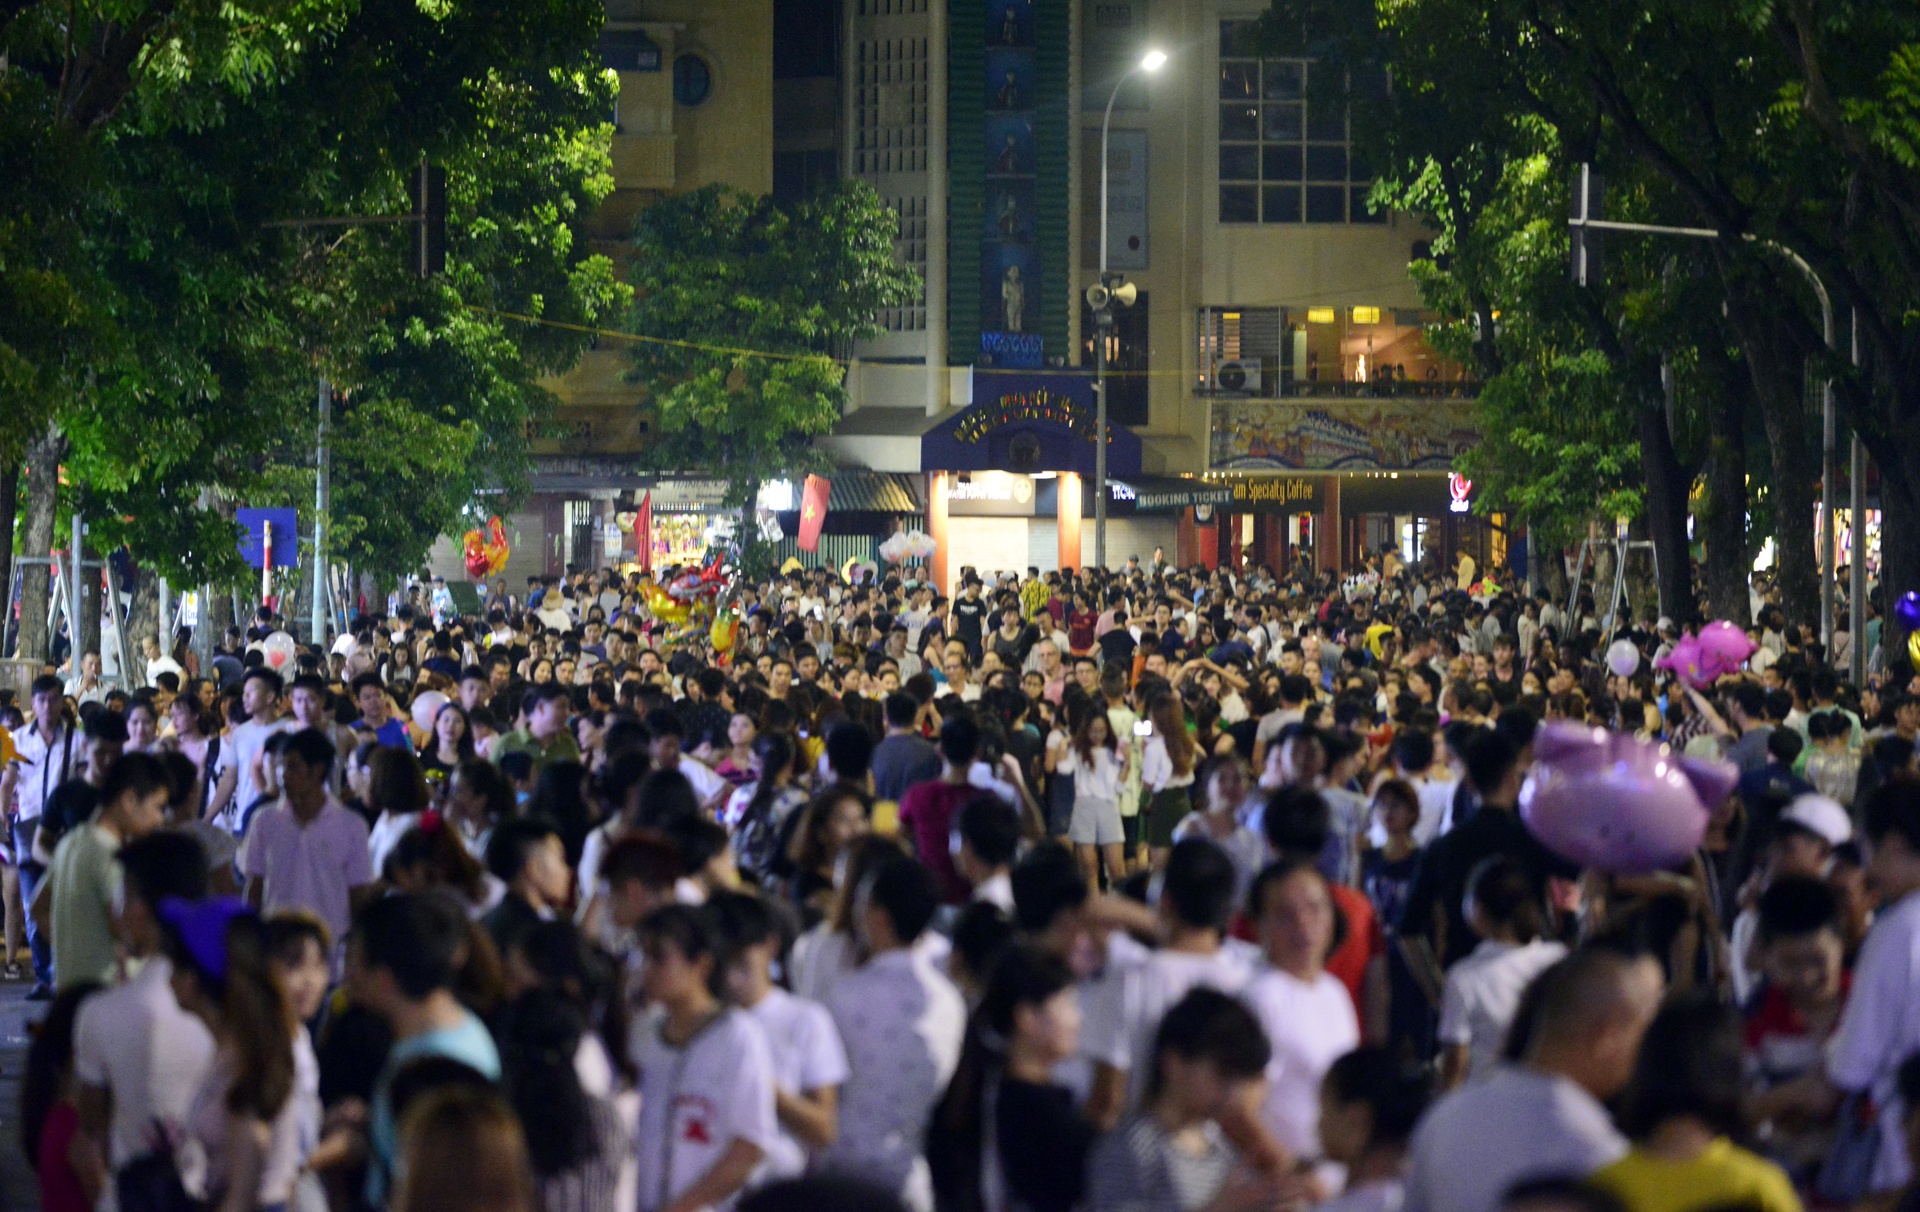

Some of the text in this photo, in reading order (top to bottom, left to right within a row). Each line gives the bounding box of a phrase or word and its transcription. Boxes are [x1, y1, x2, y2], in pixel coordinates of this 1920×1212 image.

[1192, 489, 1231, 504] TICKET
[1248, 478, 1285, 506] Specialty
[1286, 478, 1313, 500] Coffee
